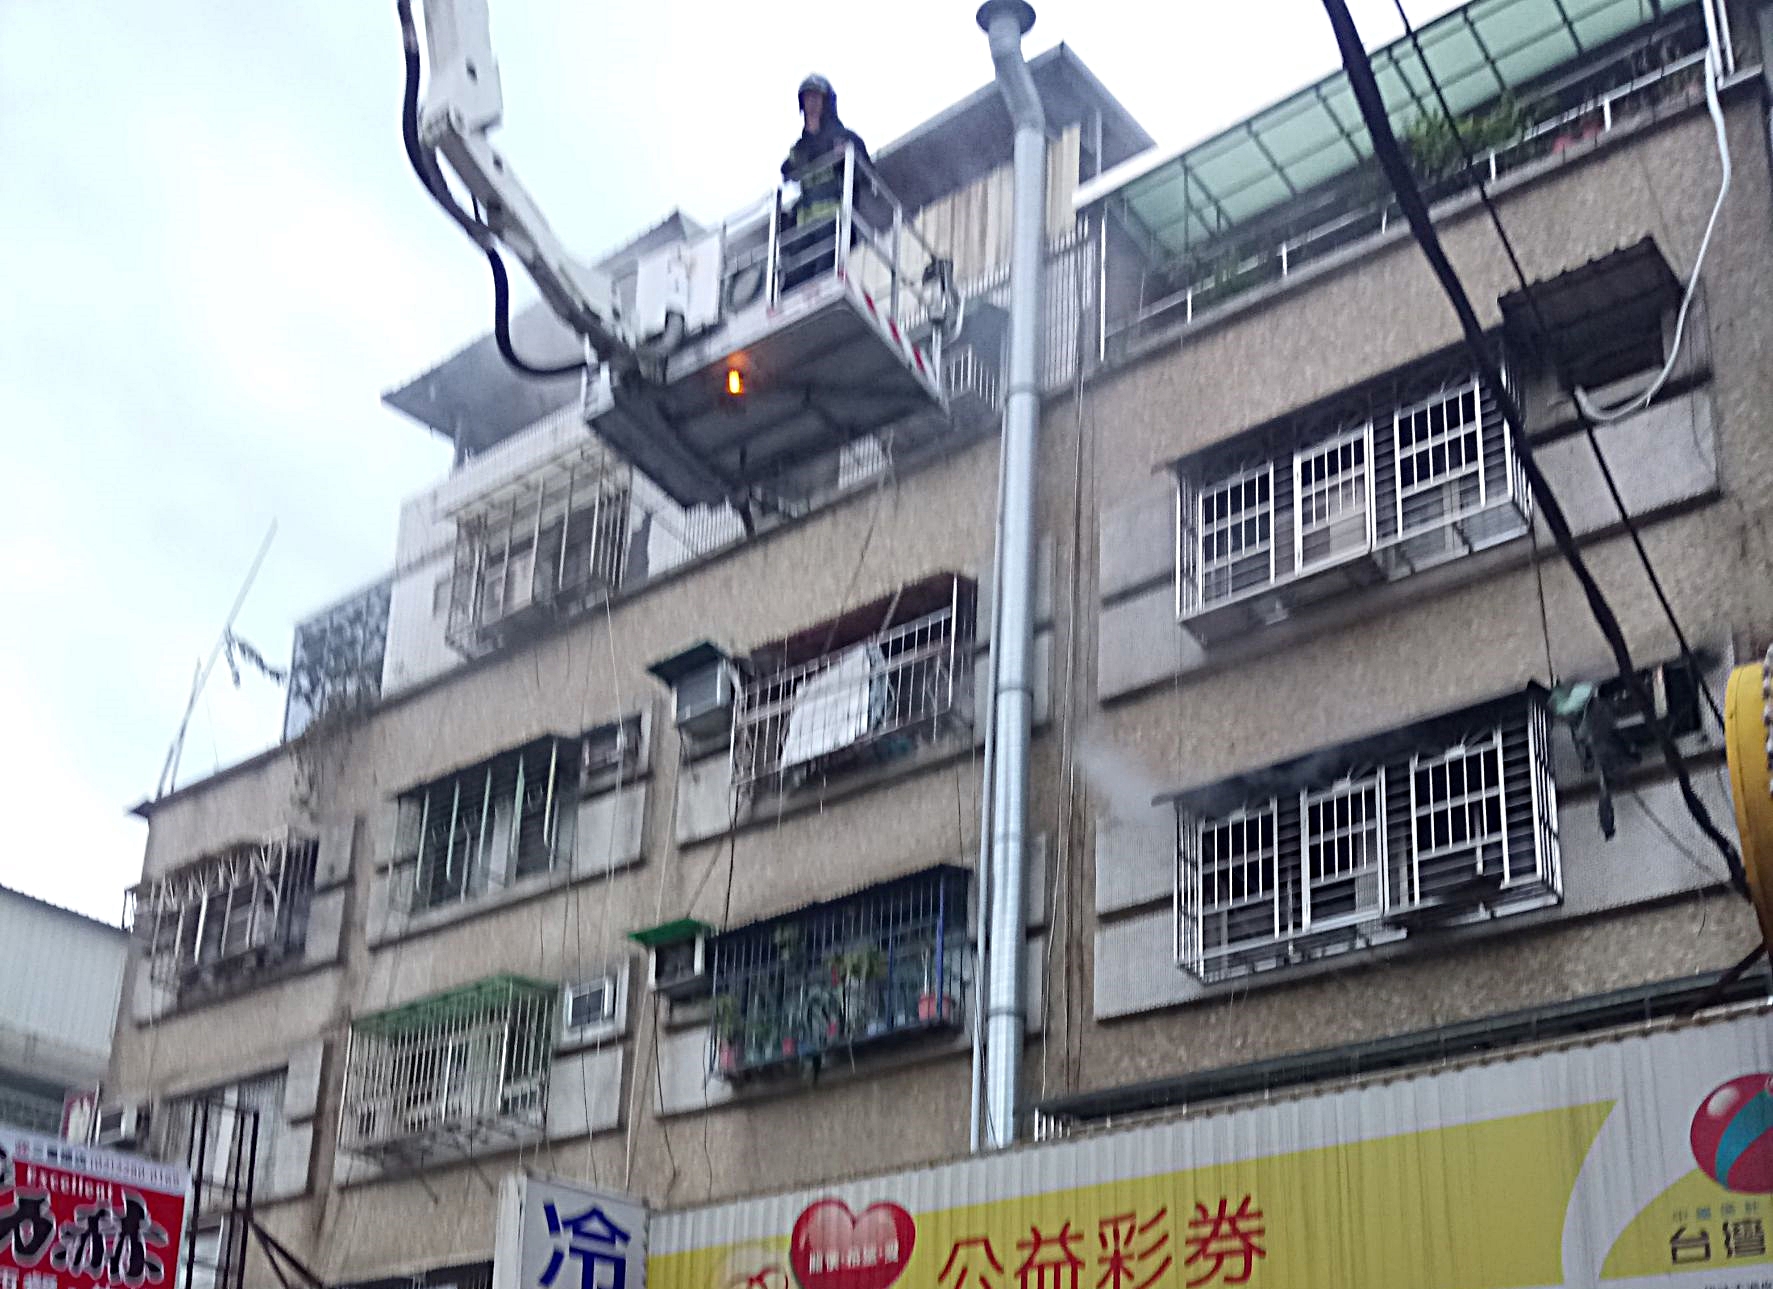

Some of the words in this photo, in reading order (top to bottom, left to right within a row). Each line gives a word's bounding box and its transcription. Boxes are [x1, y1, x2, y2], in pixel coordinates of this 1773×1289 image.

[26, 1164, 114, 1199] Excellent
[539, 1203, 631, 1289] 冷
[938, 1194, 1266, 1289] 公益彩券
[1670, 1217, 1767, 1265] 台灣
